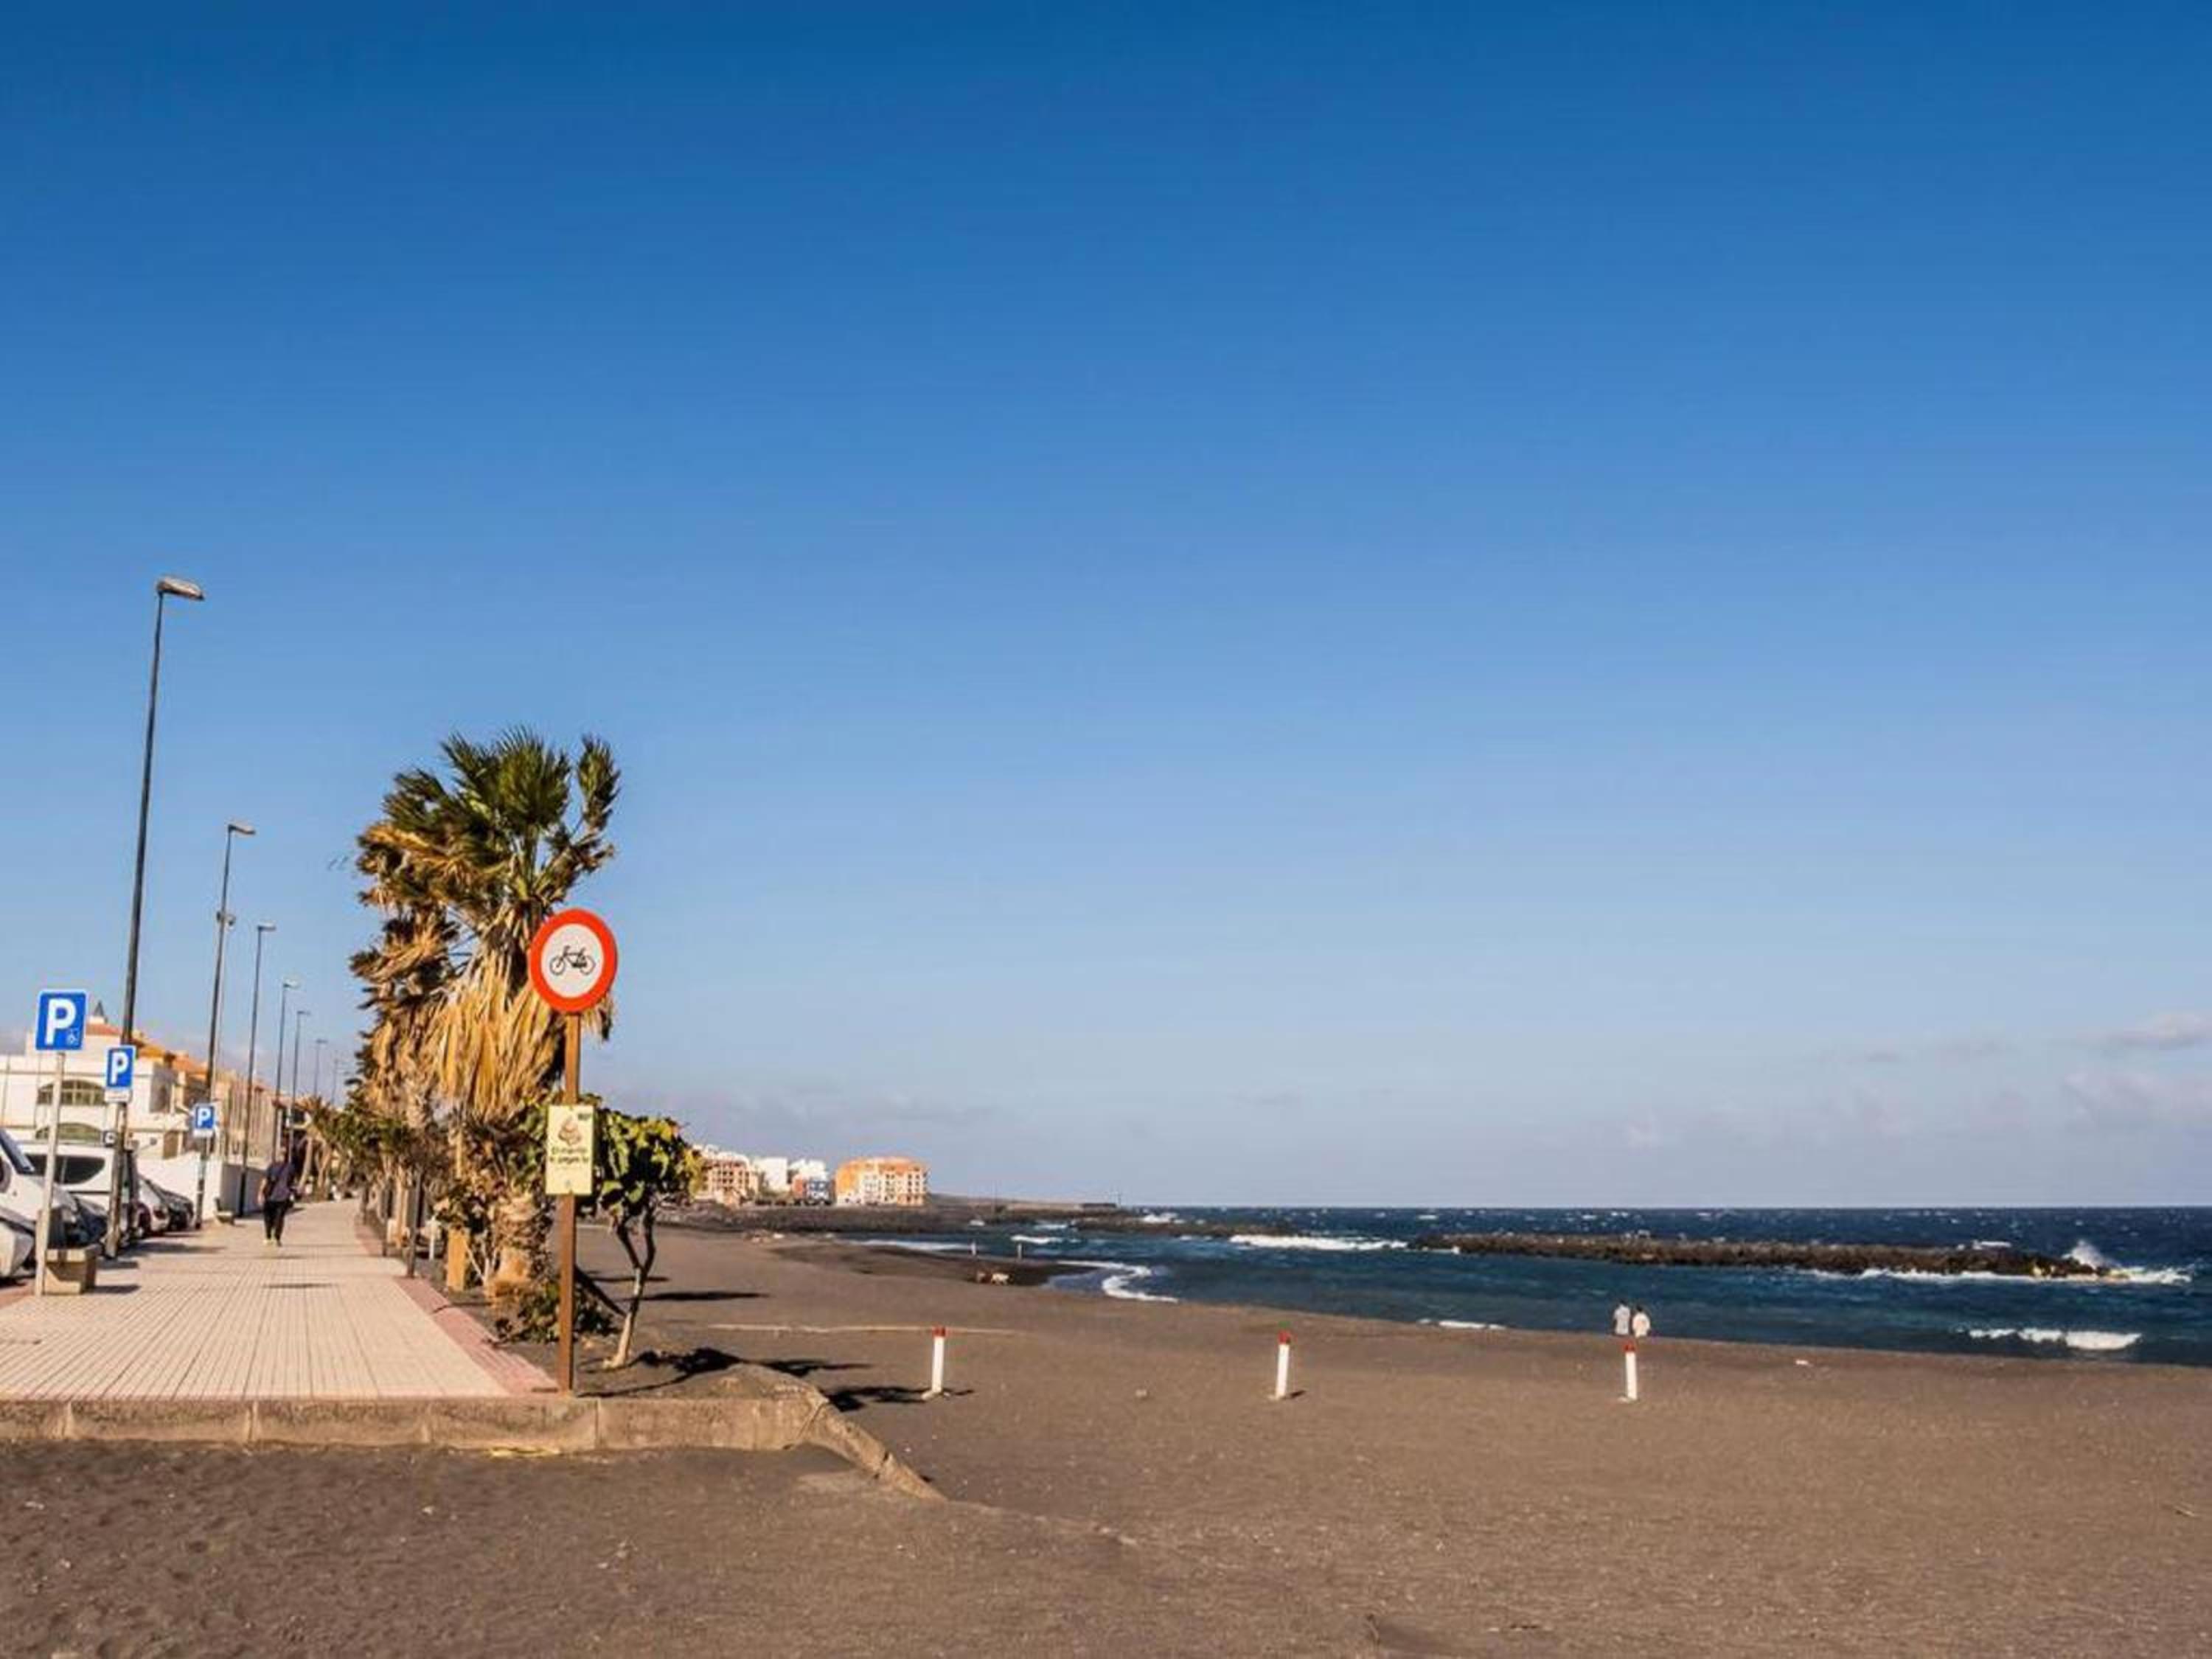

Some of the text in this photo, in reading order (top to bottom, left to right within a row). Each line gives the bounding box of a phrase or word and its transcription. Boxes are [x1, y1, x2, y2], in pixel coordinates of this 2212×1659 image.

[45, 998, 77, 1046] P
[111, 1051, 129, 1085] P
[197, 1107, 212, 1127] P
